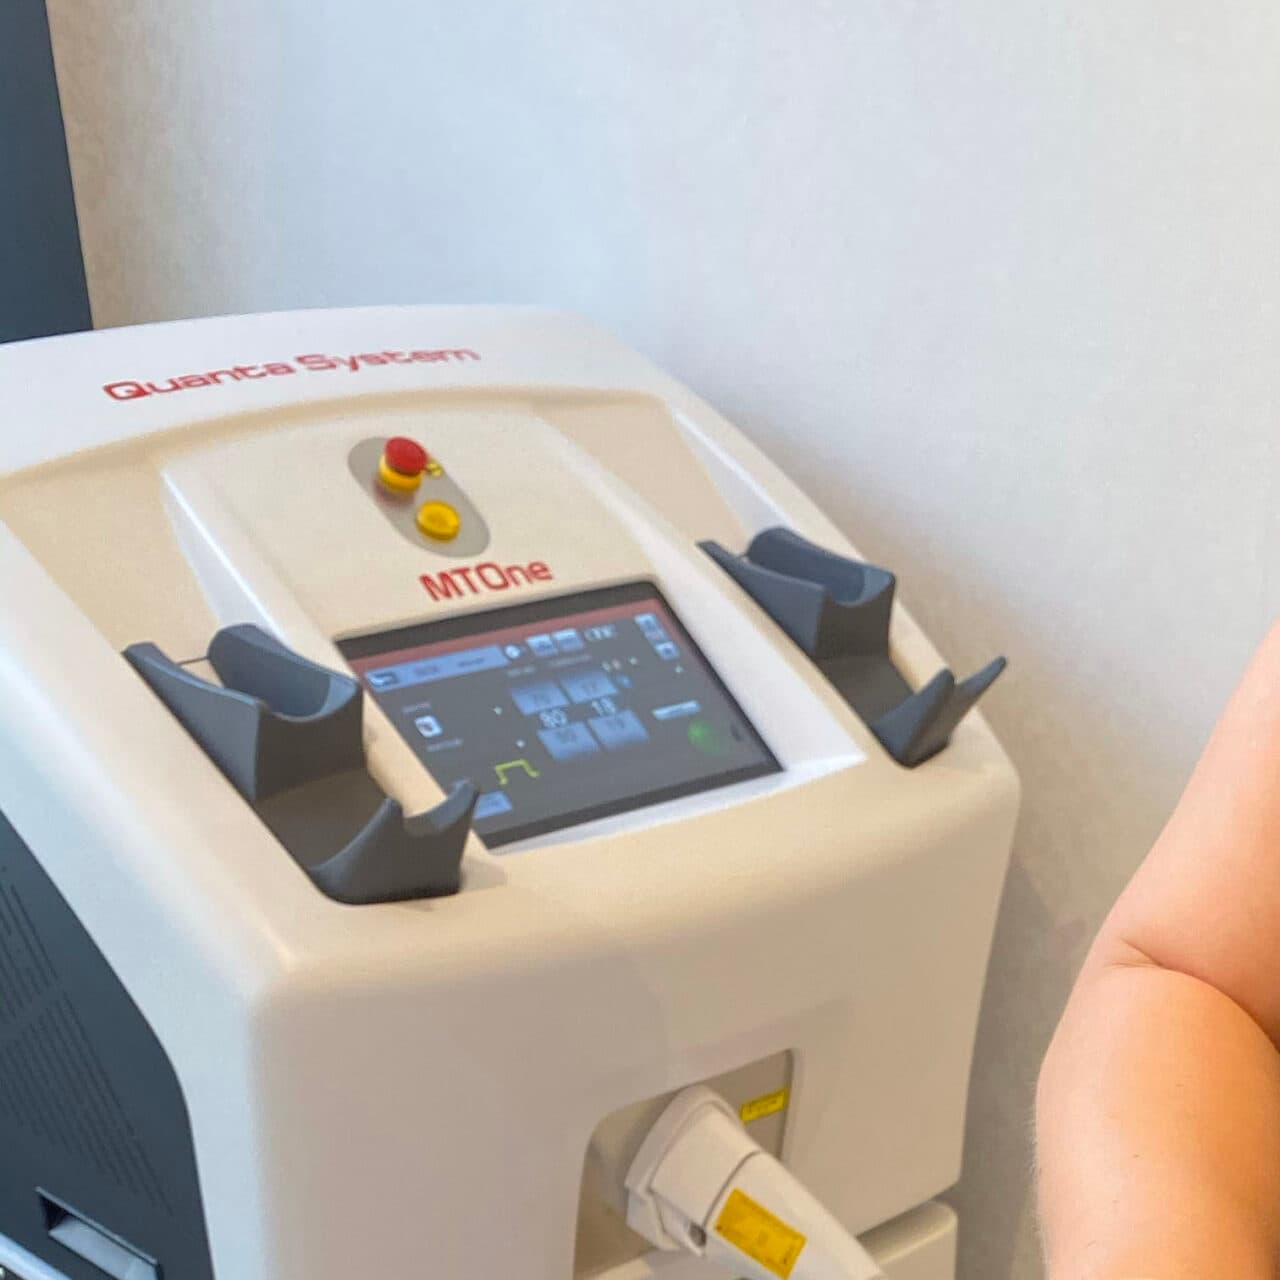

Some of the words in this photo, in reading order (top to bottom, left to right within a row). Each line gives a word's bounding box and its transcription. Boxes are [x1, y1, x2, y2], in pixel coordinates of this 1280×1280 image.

[102, 361, 296, 401] Quanta
[294, 347, 481, 372] System
[419, 560, 554, 602] MTOne
